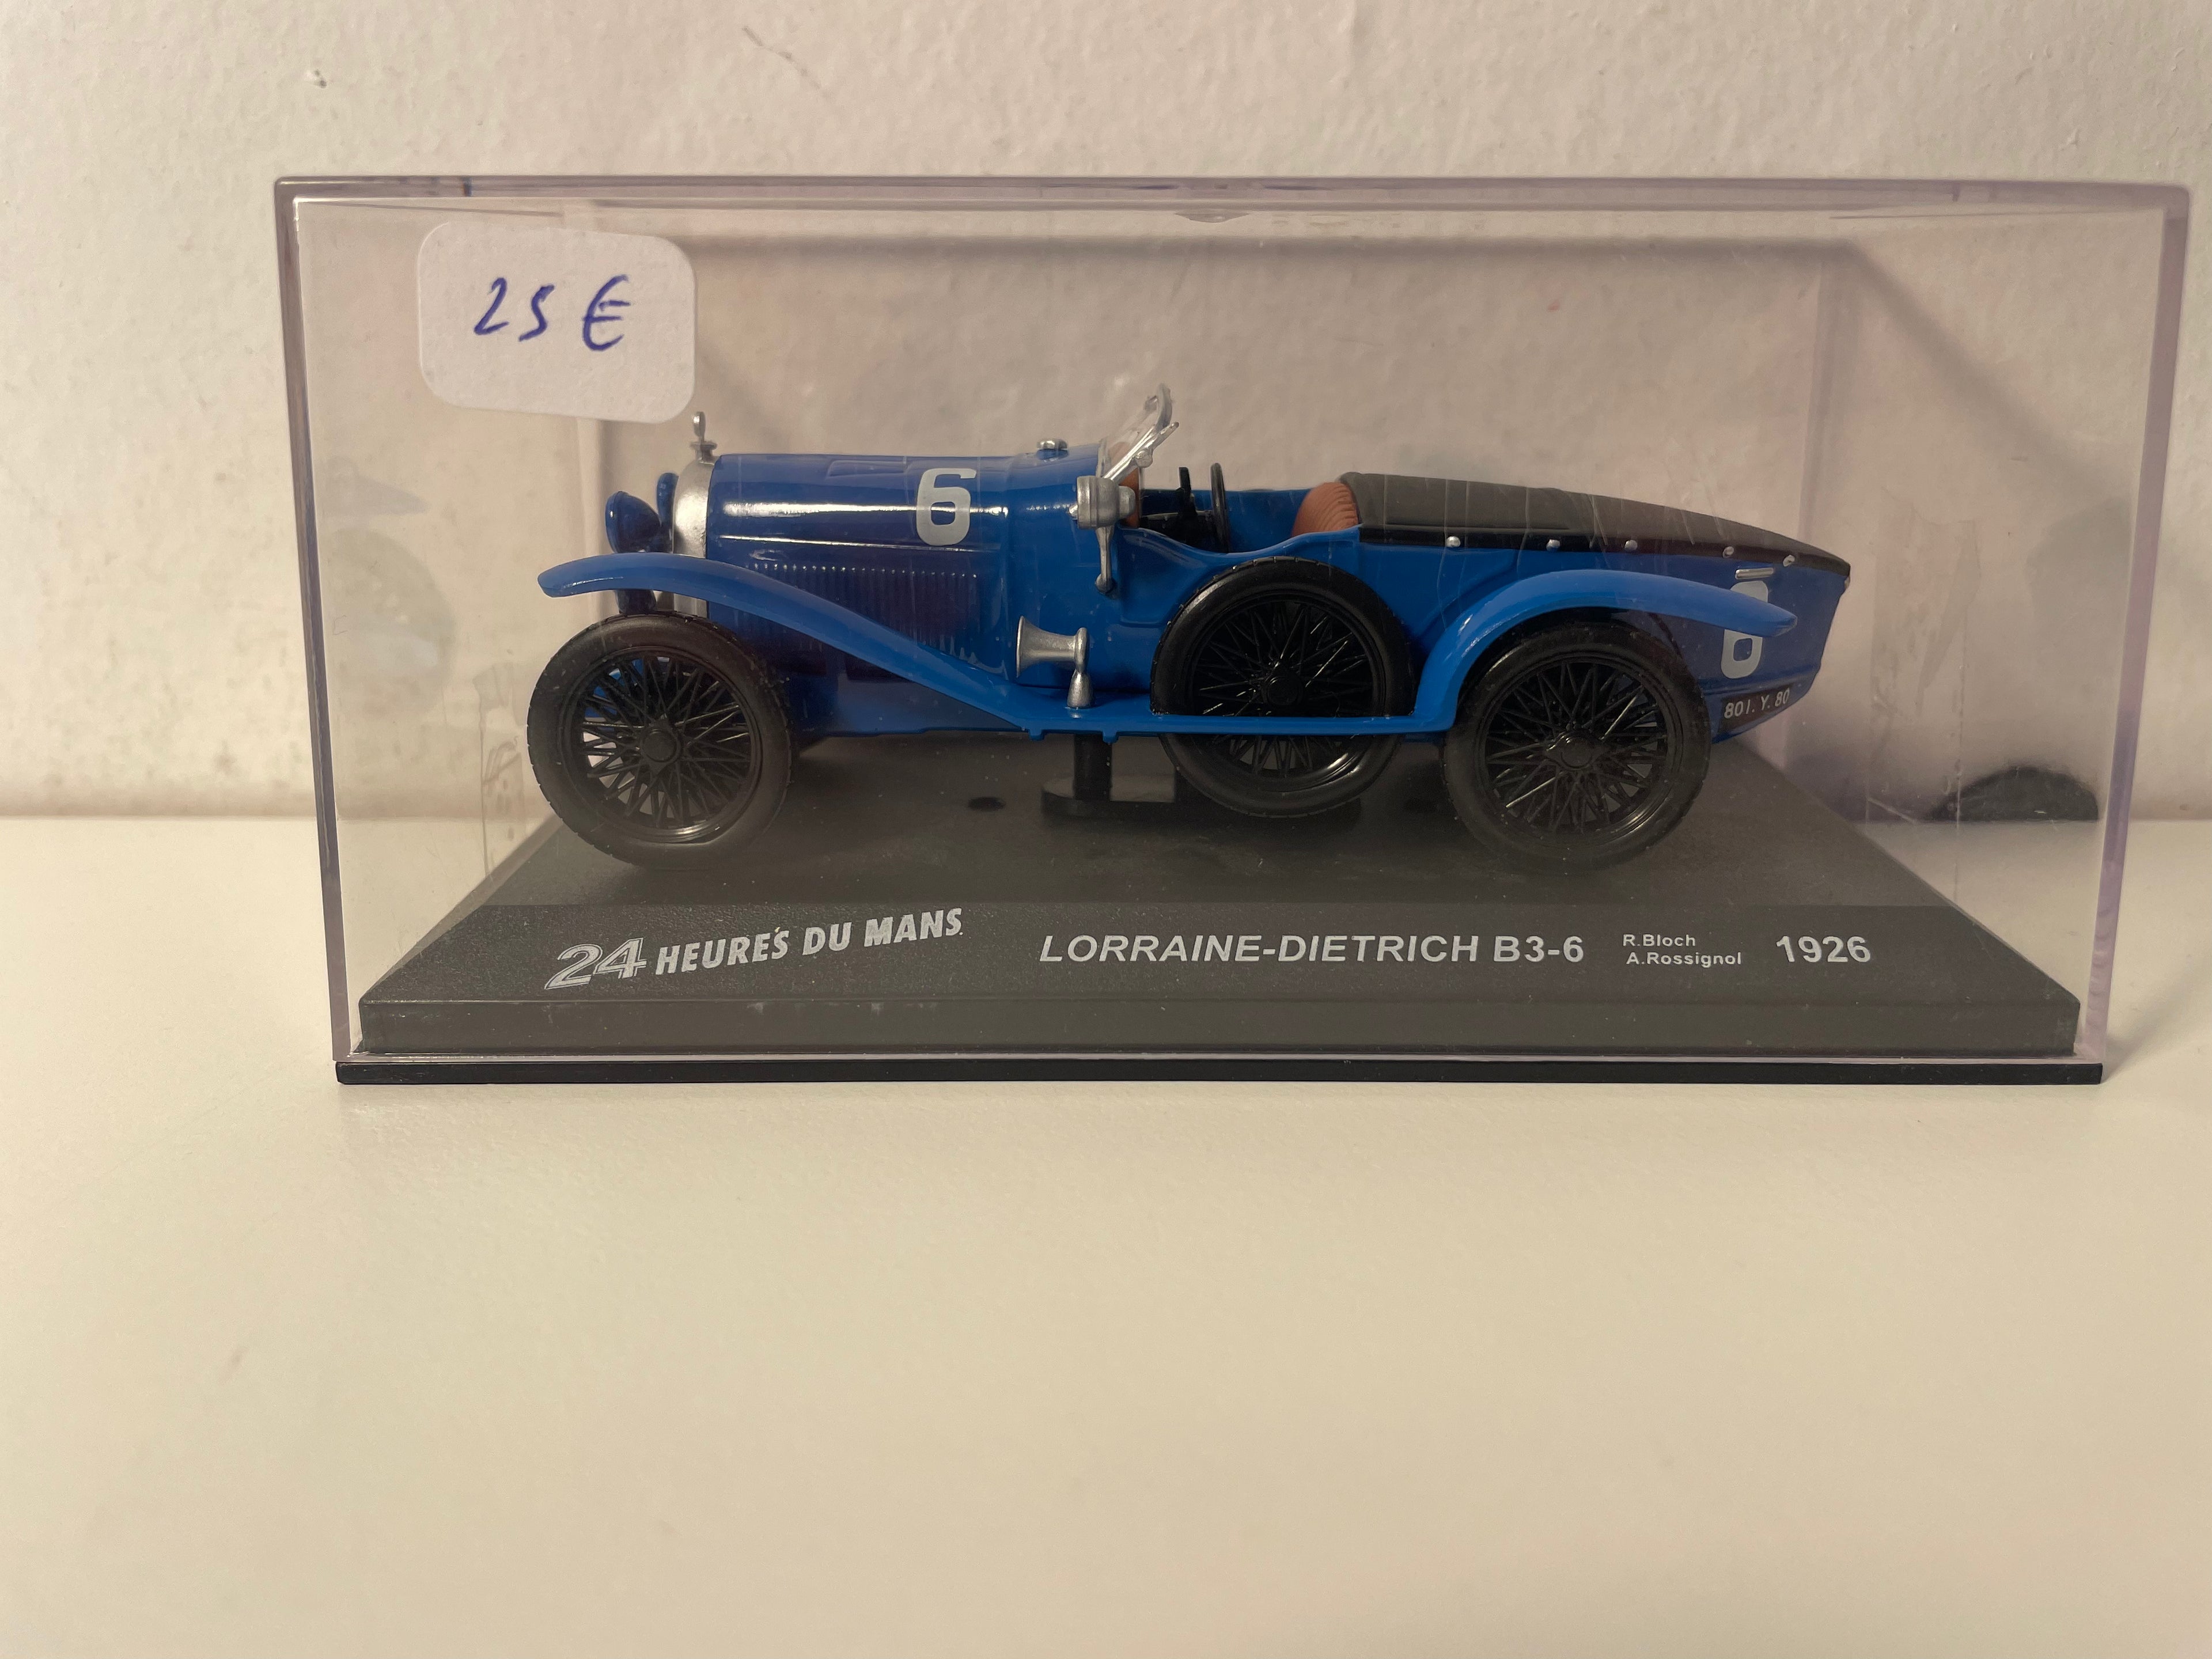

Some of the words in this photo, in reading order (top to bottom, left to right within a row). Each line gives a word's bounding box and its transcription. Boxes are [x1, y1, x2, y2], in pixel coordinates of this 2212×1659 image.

[474, 277, 555, 342] 25
[582, 273, 632, 352] €
[916, 468, 977, 547] 6
[1774, 687, 1790, 707] 80
[1039, 934, 1479, 963] LORRAINE-DIETRICH
[1493, 935, 1584, 963] B3-6
[1622, 933, 1696, 947] R.Bloch
[1775, 935, 1871, 963] 1926
[544, 937, 647, 990] 24
[655, 930, 790, 975] HEURES
[801, 922, 852, 956] DU
[1626, 951, 1741, 968] A.Rossignol
